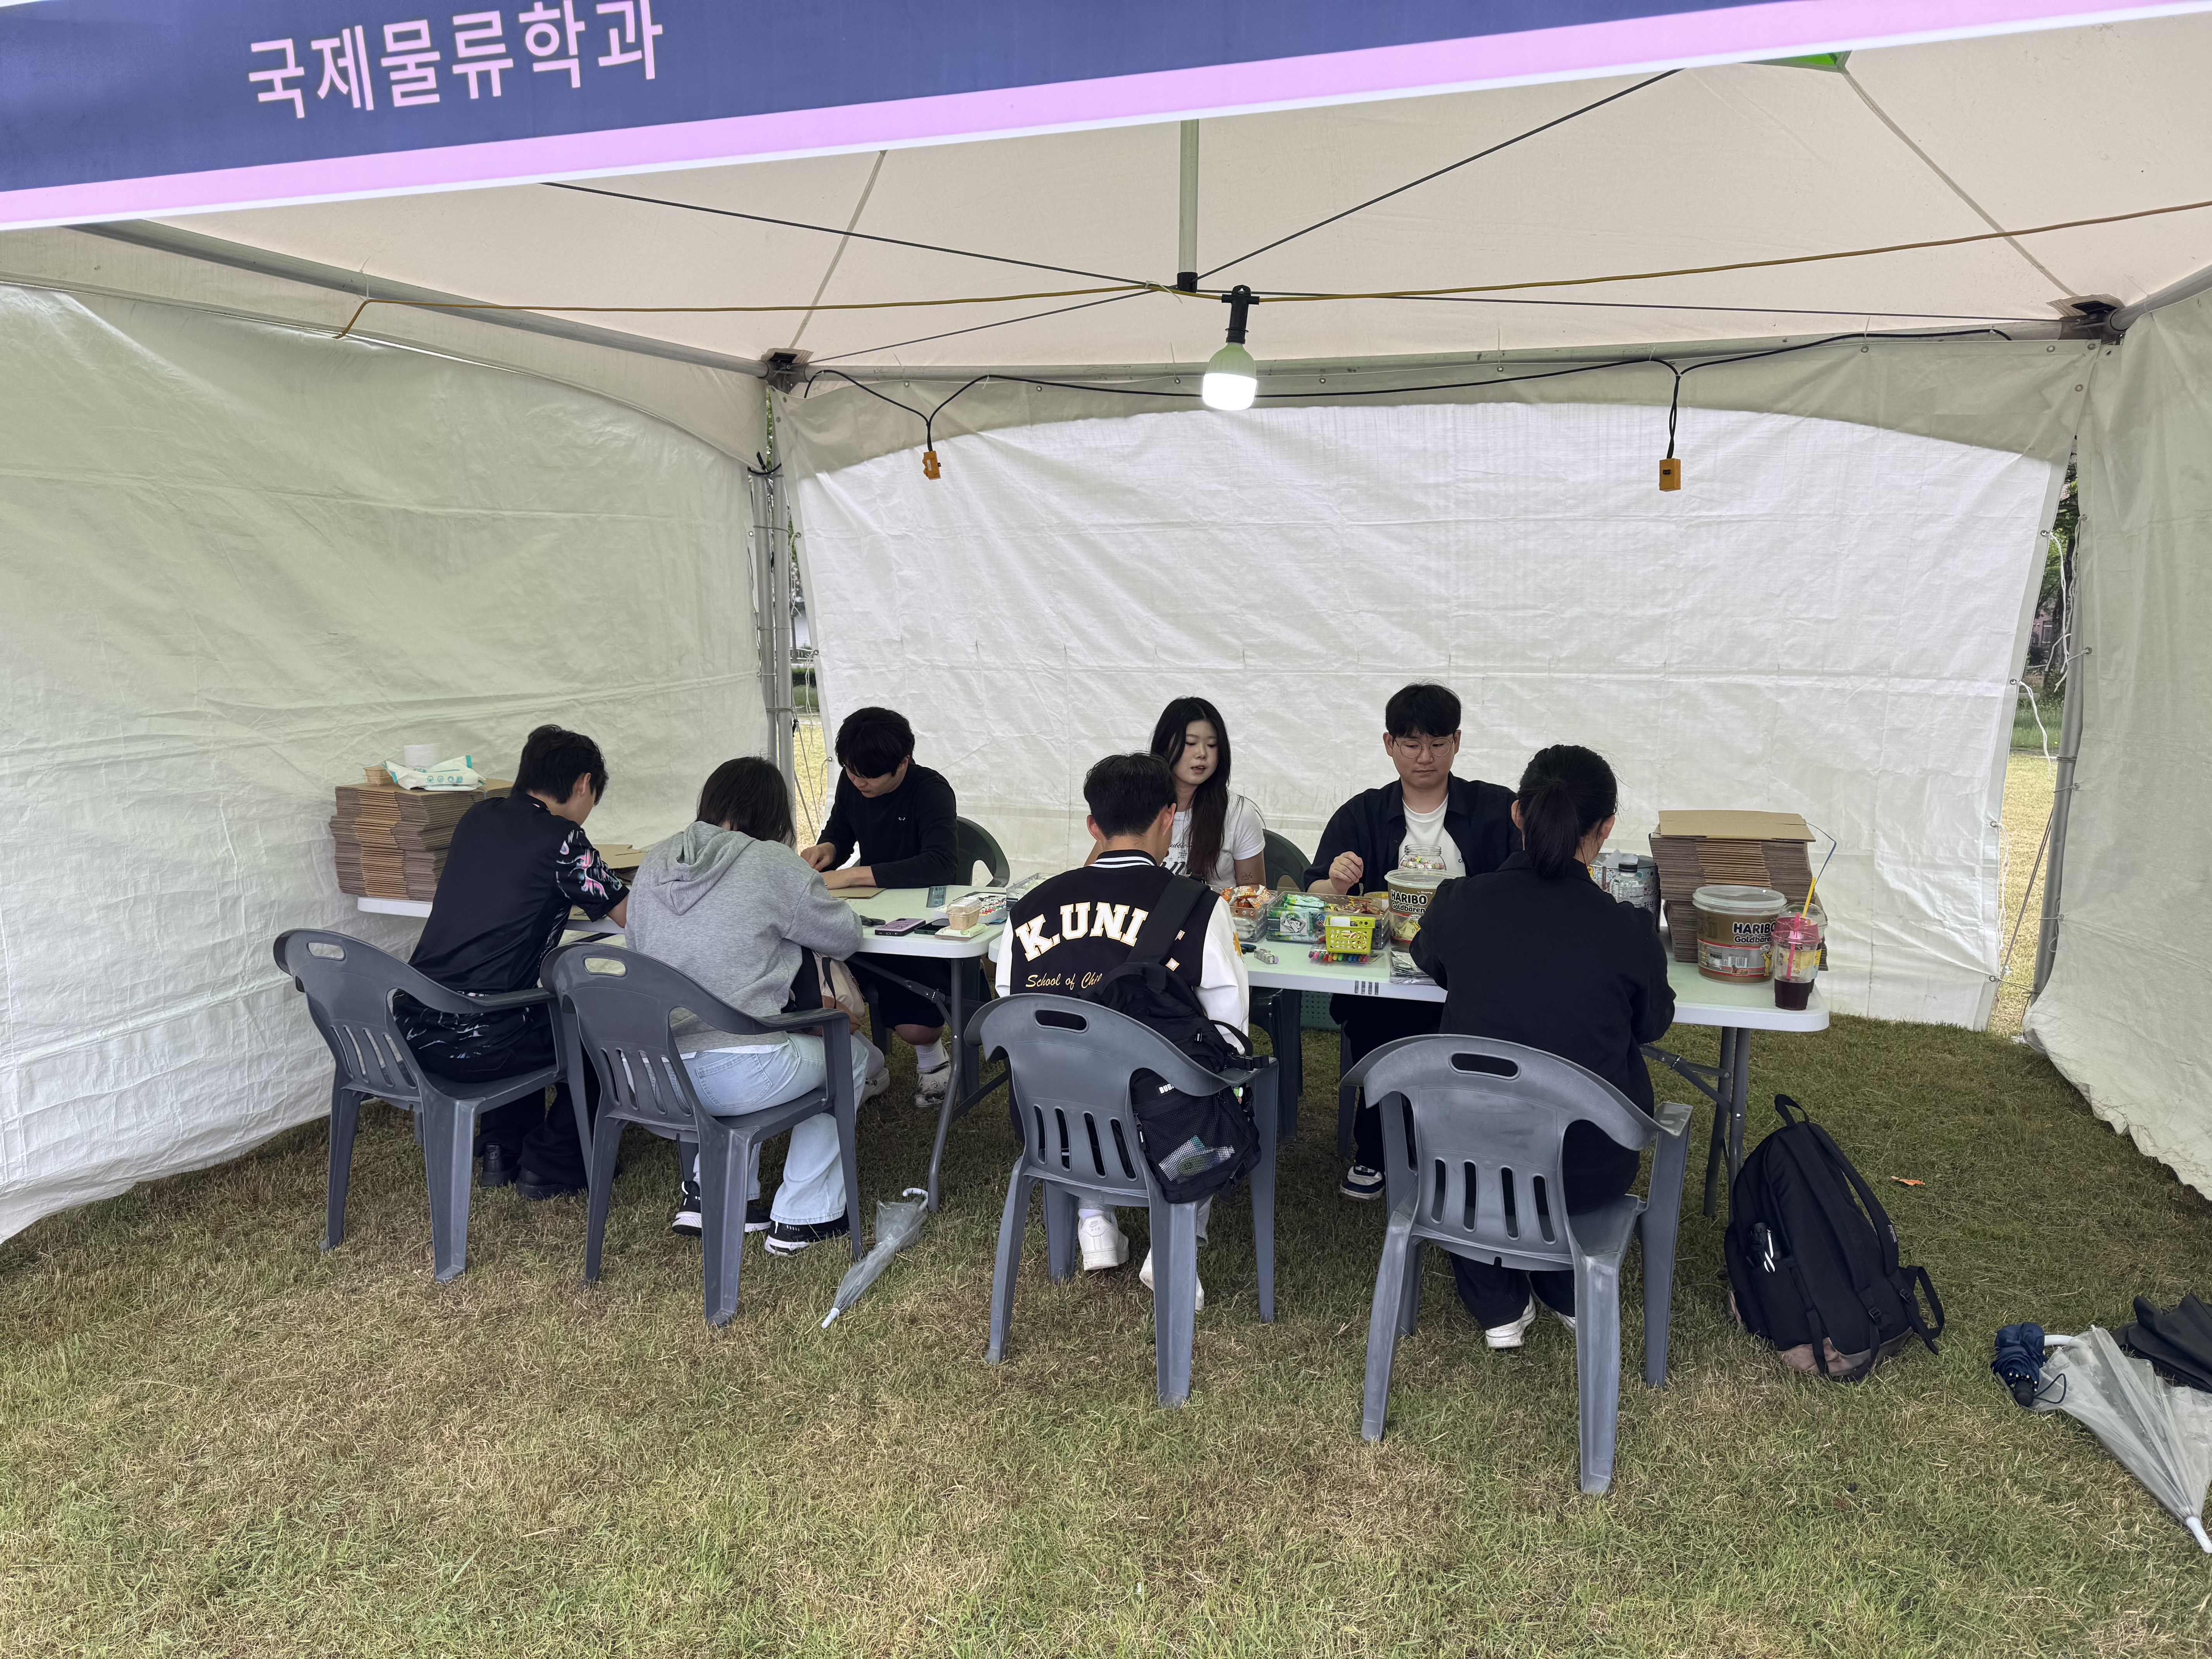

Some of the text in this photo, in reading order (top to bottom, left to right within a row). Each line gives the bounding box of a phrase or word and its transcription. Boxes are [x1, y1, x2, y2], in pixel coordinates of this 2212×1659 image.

[249, 0, 663, 118] 국제물류학과
[1391, 890, 1428, 905] HARIBO
[1392, 902, 1426, 914] Goldbären
[1734, 935, 1772, 944] Goldbäre
[1025, 973, 1061, 988] School
[1065, 973, 1076, 990] of
